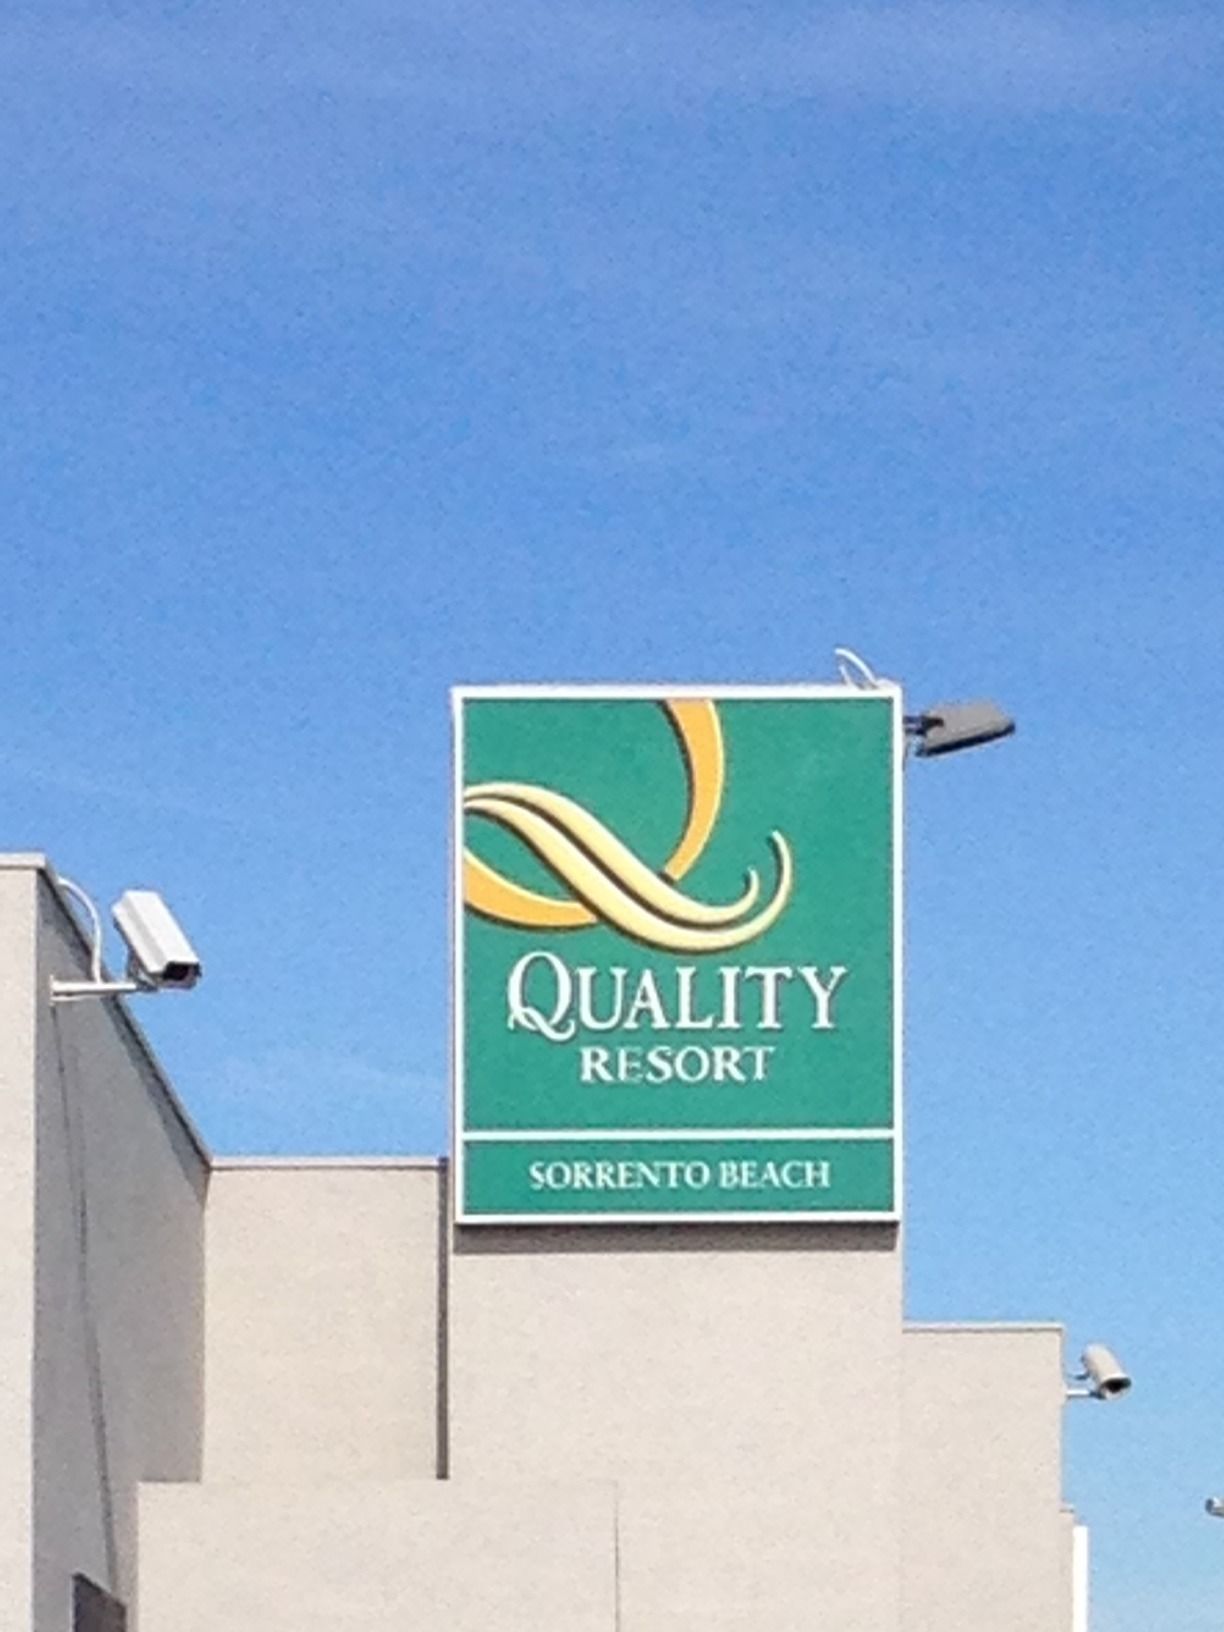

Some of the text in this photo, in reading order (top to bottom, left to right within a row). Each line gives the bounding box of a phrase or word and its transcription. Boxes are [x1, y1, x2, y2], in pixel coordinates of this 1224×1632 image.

[507, 951, 847, 1042] QUALITY
[580, 1045, 775, 1083] RESORT
[529, 1160, 832, 1190] SORRENTO BEACH
